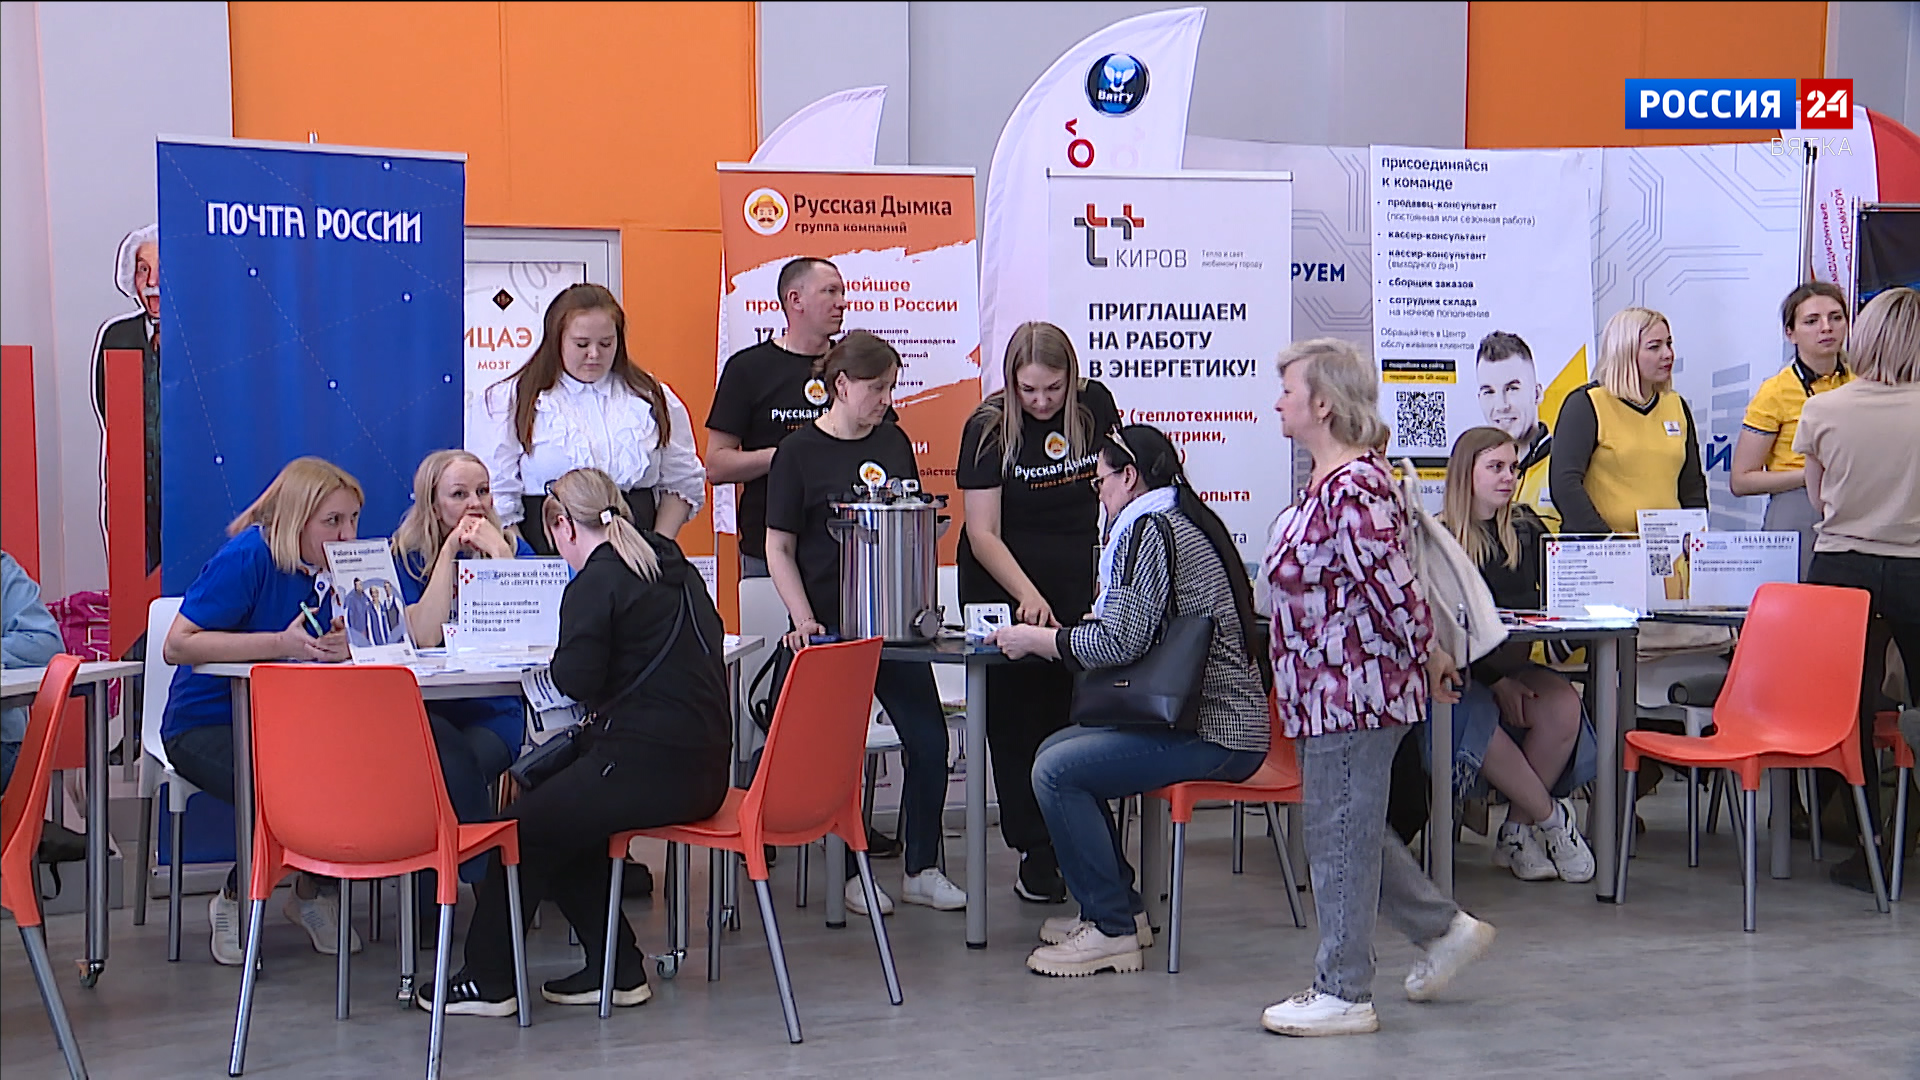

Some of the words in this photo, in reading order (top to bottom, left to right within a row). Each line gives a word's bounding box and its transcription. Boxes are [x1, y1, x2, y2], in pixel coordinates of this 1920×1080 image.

[1394, 177, 1453, 191] команде
[793, 194, 877, 218] Русская
[881, 195, 953, 218] Дымка
[1387, 199, 1497, 212] продавец-консультант
[207, 202, 306, 238] ПОЧТА
[316, 206, 422, 243] РОССИИ
[794, 222, 840, 235] группа
[843, 221, 908, 234] компаний
[1388, 231, 1487, 243] кассир-консультант
[1115, 248, 1187, 268] КИРОВ
[1388, 250, 1487, 261] кассир-консультант
[1290, 262, 1346, 282] РУЕМ
[1388, 277, 1433, 288] сборщик
[1435, 280, 1474, 288] заказов
[879, 301, 890, 312] в
[895, 297, 958, 312] России
[1389, 297, 1441, 308] сотрудник
[1442, 298, 1478, 307] склада
[1088, 303, 1247, 321] ПРИГЛАШАЕМ
[1088, 331, 1119, 350] НА
[1126, 331, 1213, 350] РАБОТУ
[1088, 359, 1103, 378] В
[1108, 358, 1257, 378] ЭНЕРГЕТИКУ!
[771, 407, 819, 422] Русская
[1129, 408, 1258, 426] (теплотехники,
[1014, 463, 1063, 481] Русская
[1063, 452, 1099, 476] Дымк
[1199, 490, 1250, 502] опыта
